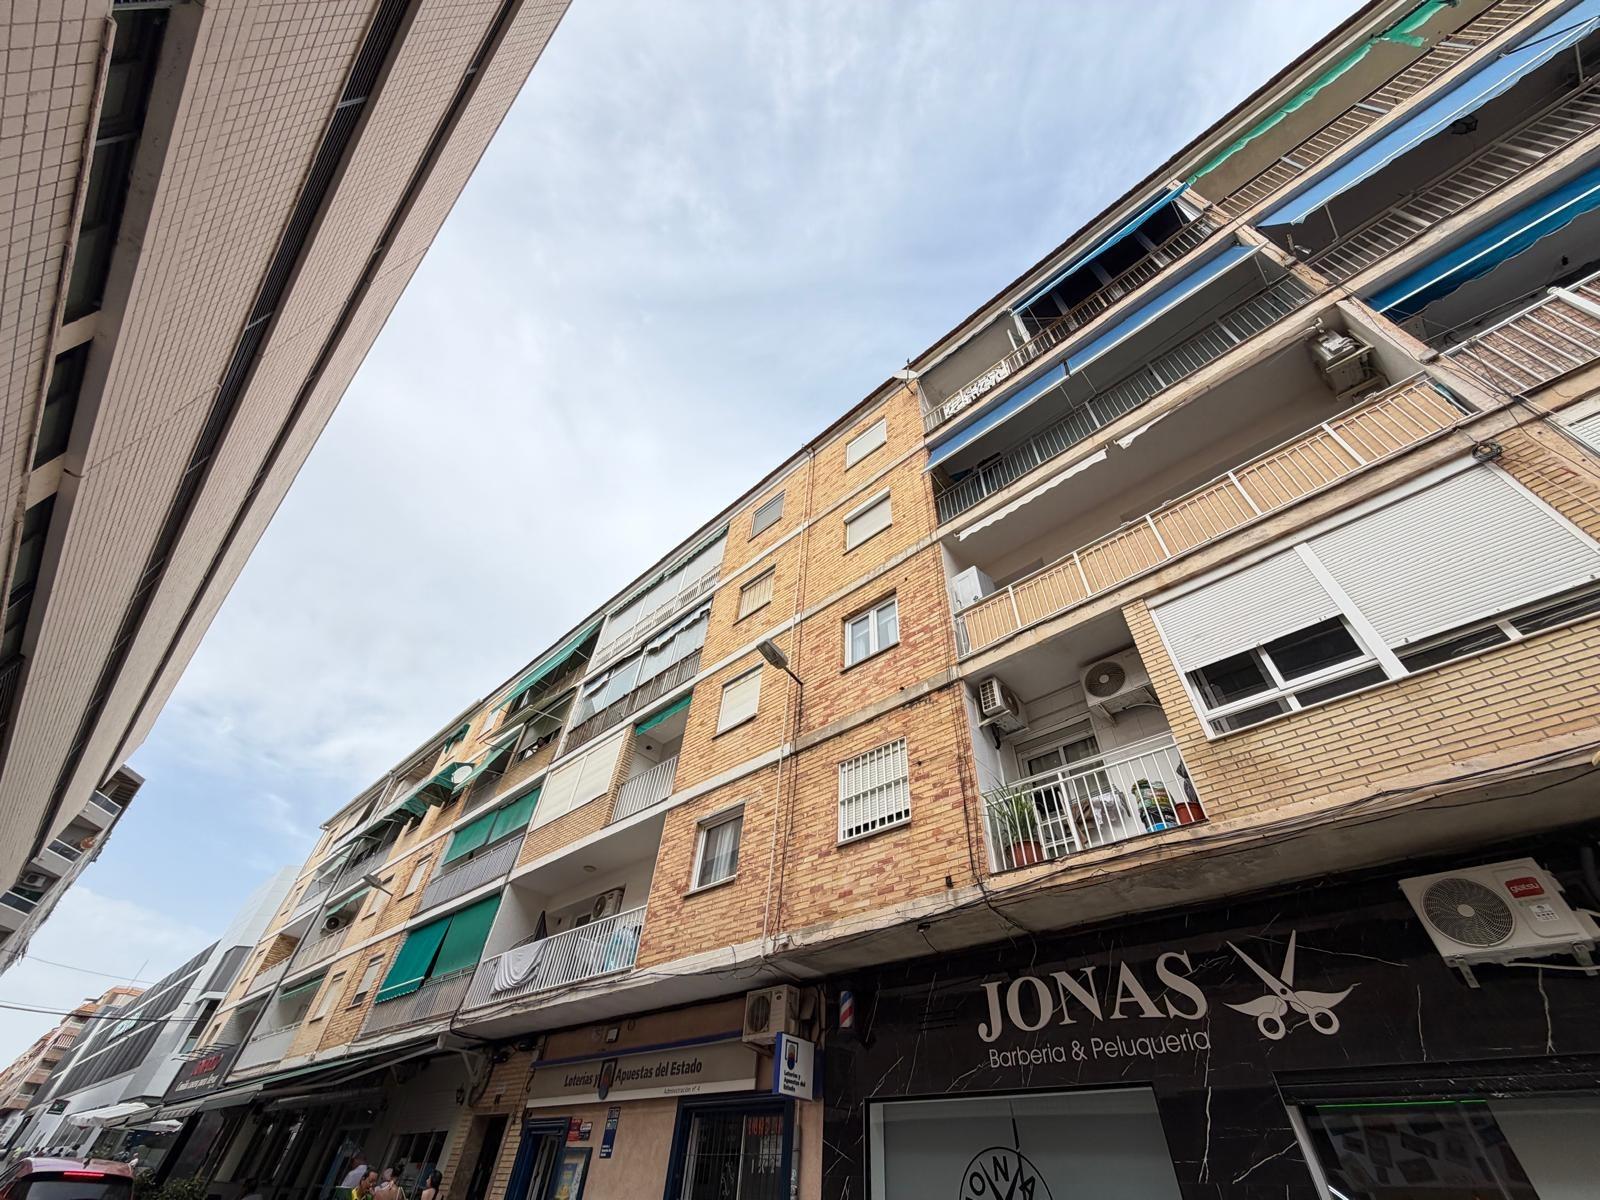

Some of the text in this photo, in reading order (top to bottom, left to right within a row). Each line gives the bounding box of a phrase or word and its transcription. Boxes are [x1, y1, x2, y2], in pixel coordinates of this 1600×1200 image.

[978, 951, 1208, 1042] JONAS
[988, 1028, 1212, 1068] Barberia & Peluqueria
[615, 1066, 653, 1085] Apuestas
[655, 1061, 670, 1077] del
[670, 1057, 702, 1075] Estado
